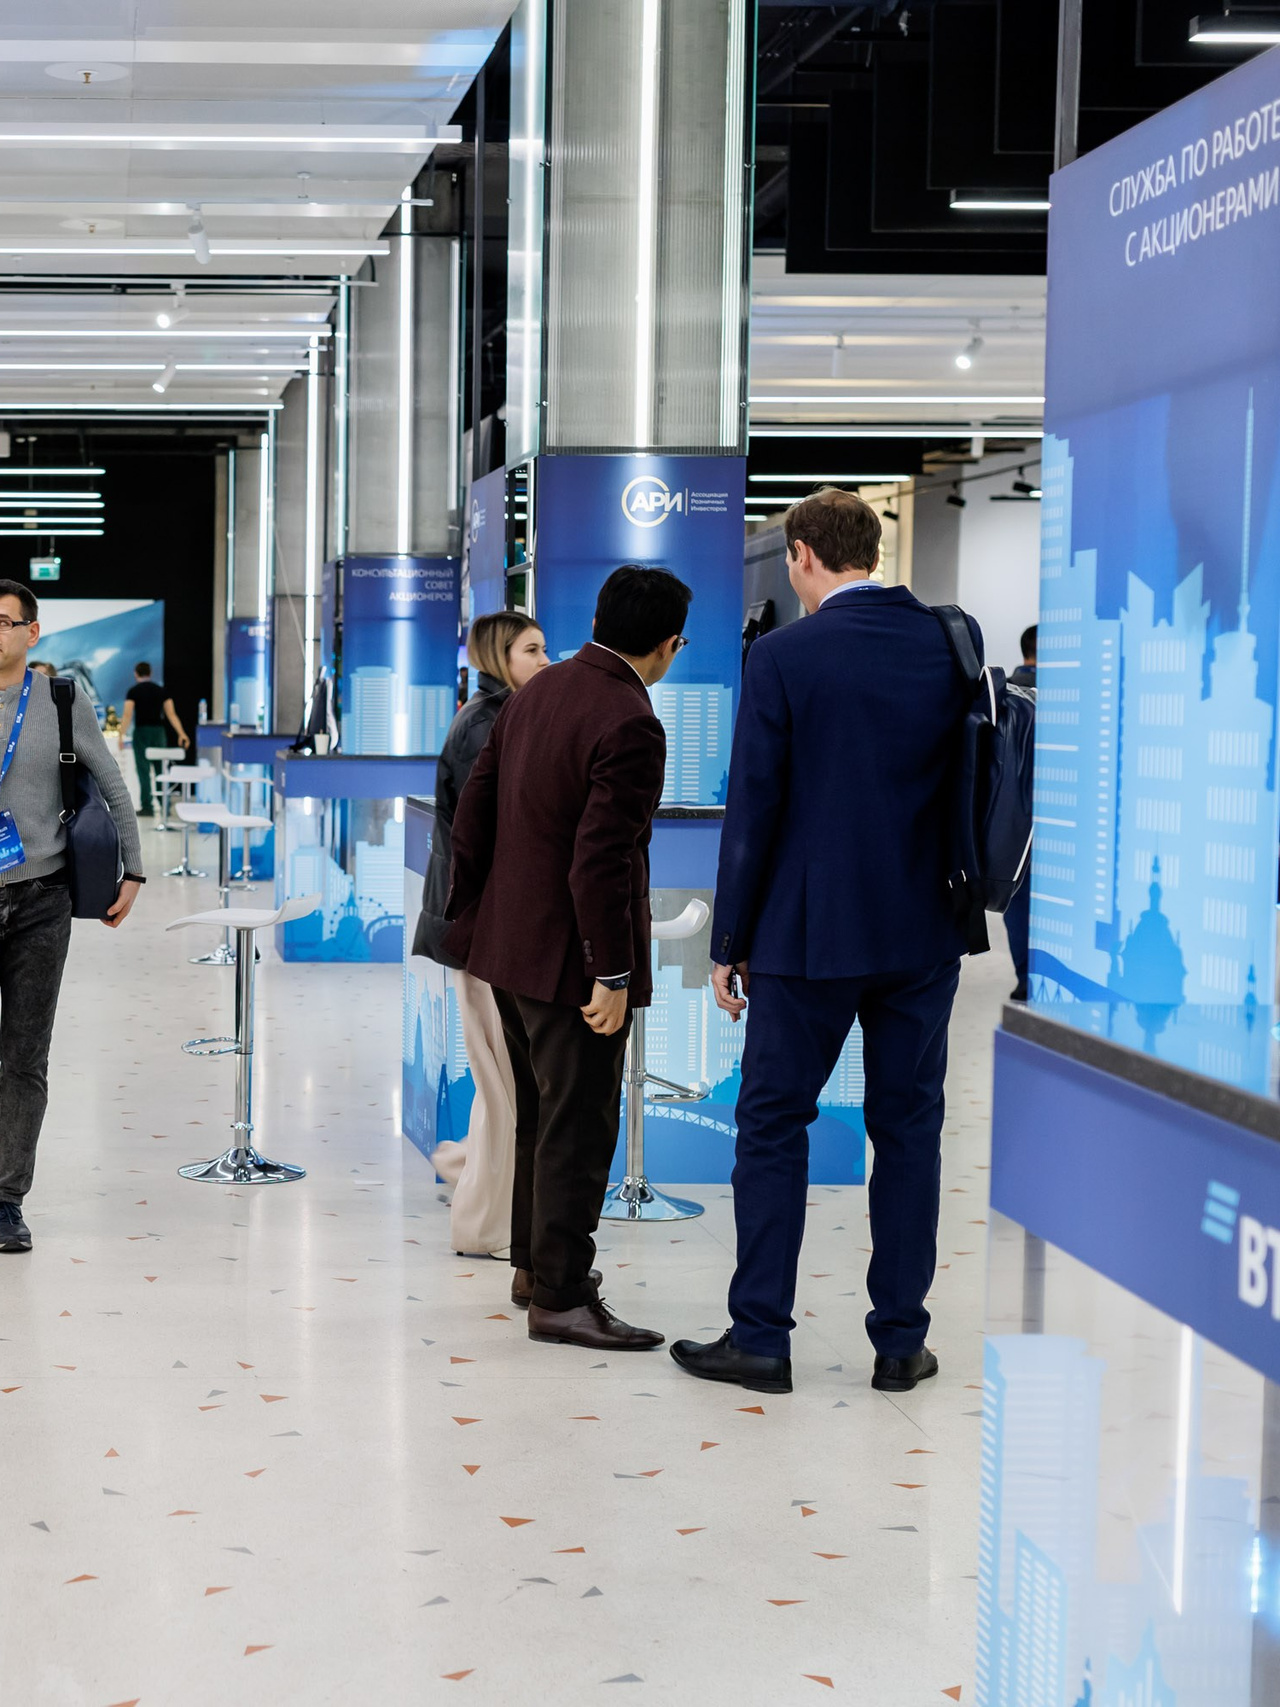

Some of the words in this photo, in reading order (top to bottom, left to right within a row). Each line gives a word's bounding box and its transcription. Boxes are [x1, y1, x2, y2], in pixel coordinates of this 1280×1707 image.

[1109, 154, 1177, 217] СЛУЖБА
[1181, 138, 1208, 184] ПО
[1212, 99, 1280, 169] РАБОТЕ
[1125, 231, 1137, 267] С
[1139, 166, 1280, 262] АКЦИОНЕРАМИ
[630, 492, 682, 512] АРИ
[424, 581, 453, 590] СОВЕТ
[389, 592, 454, 601] АКЦИОНЕРОВ
